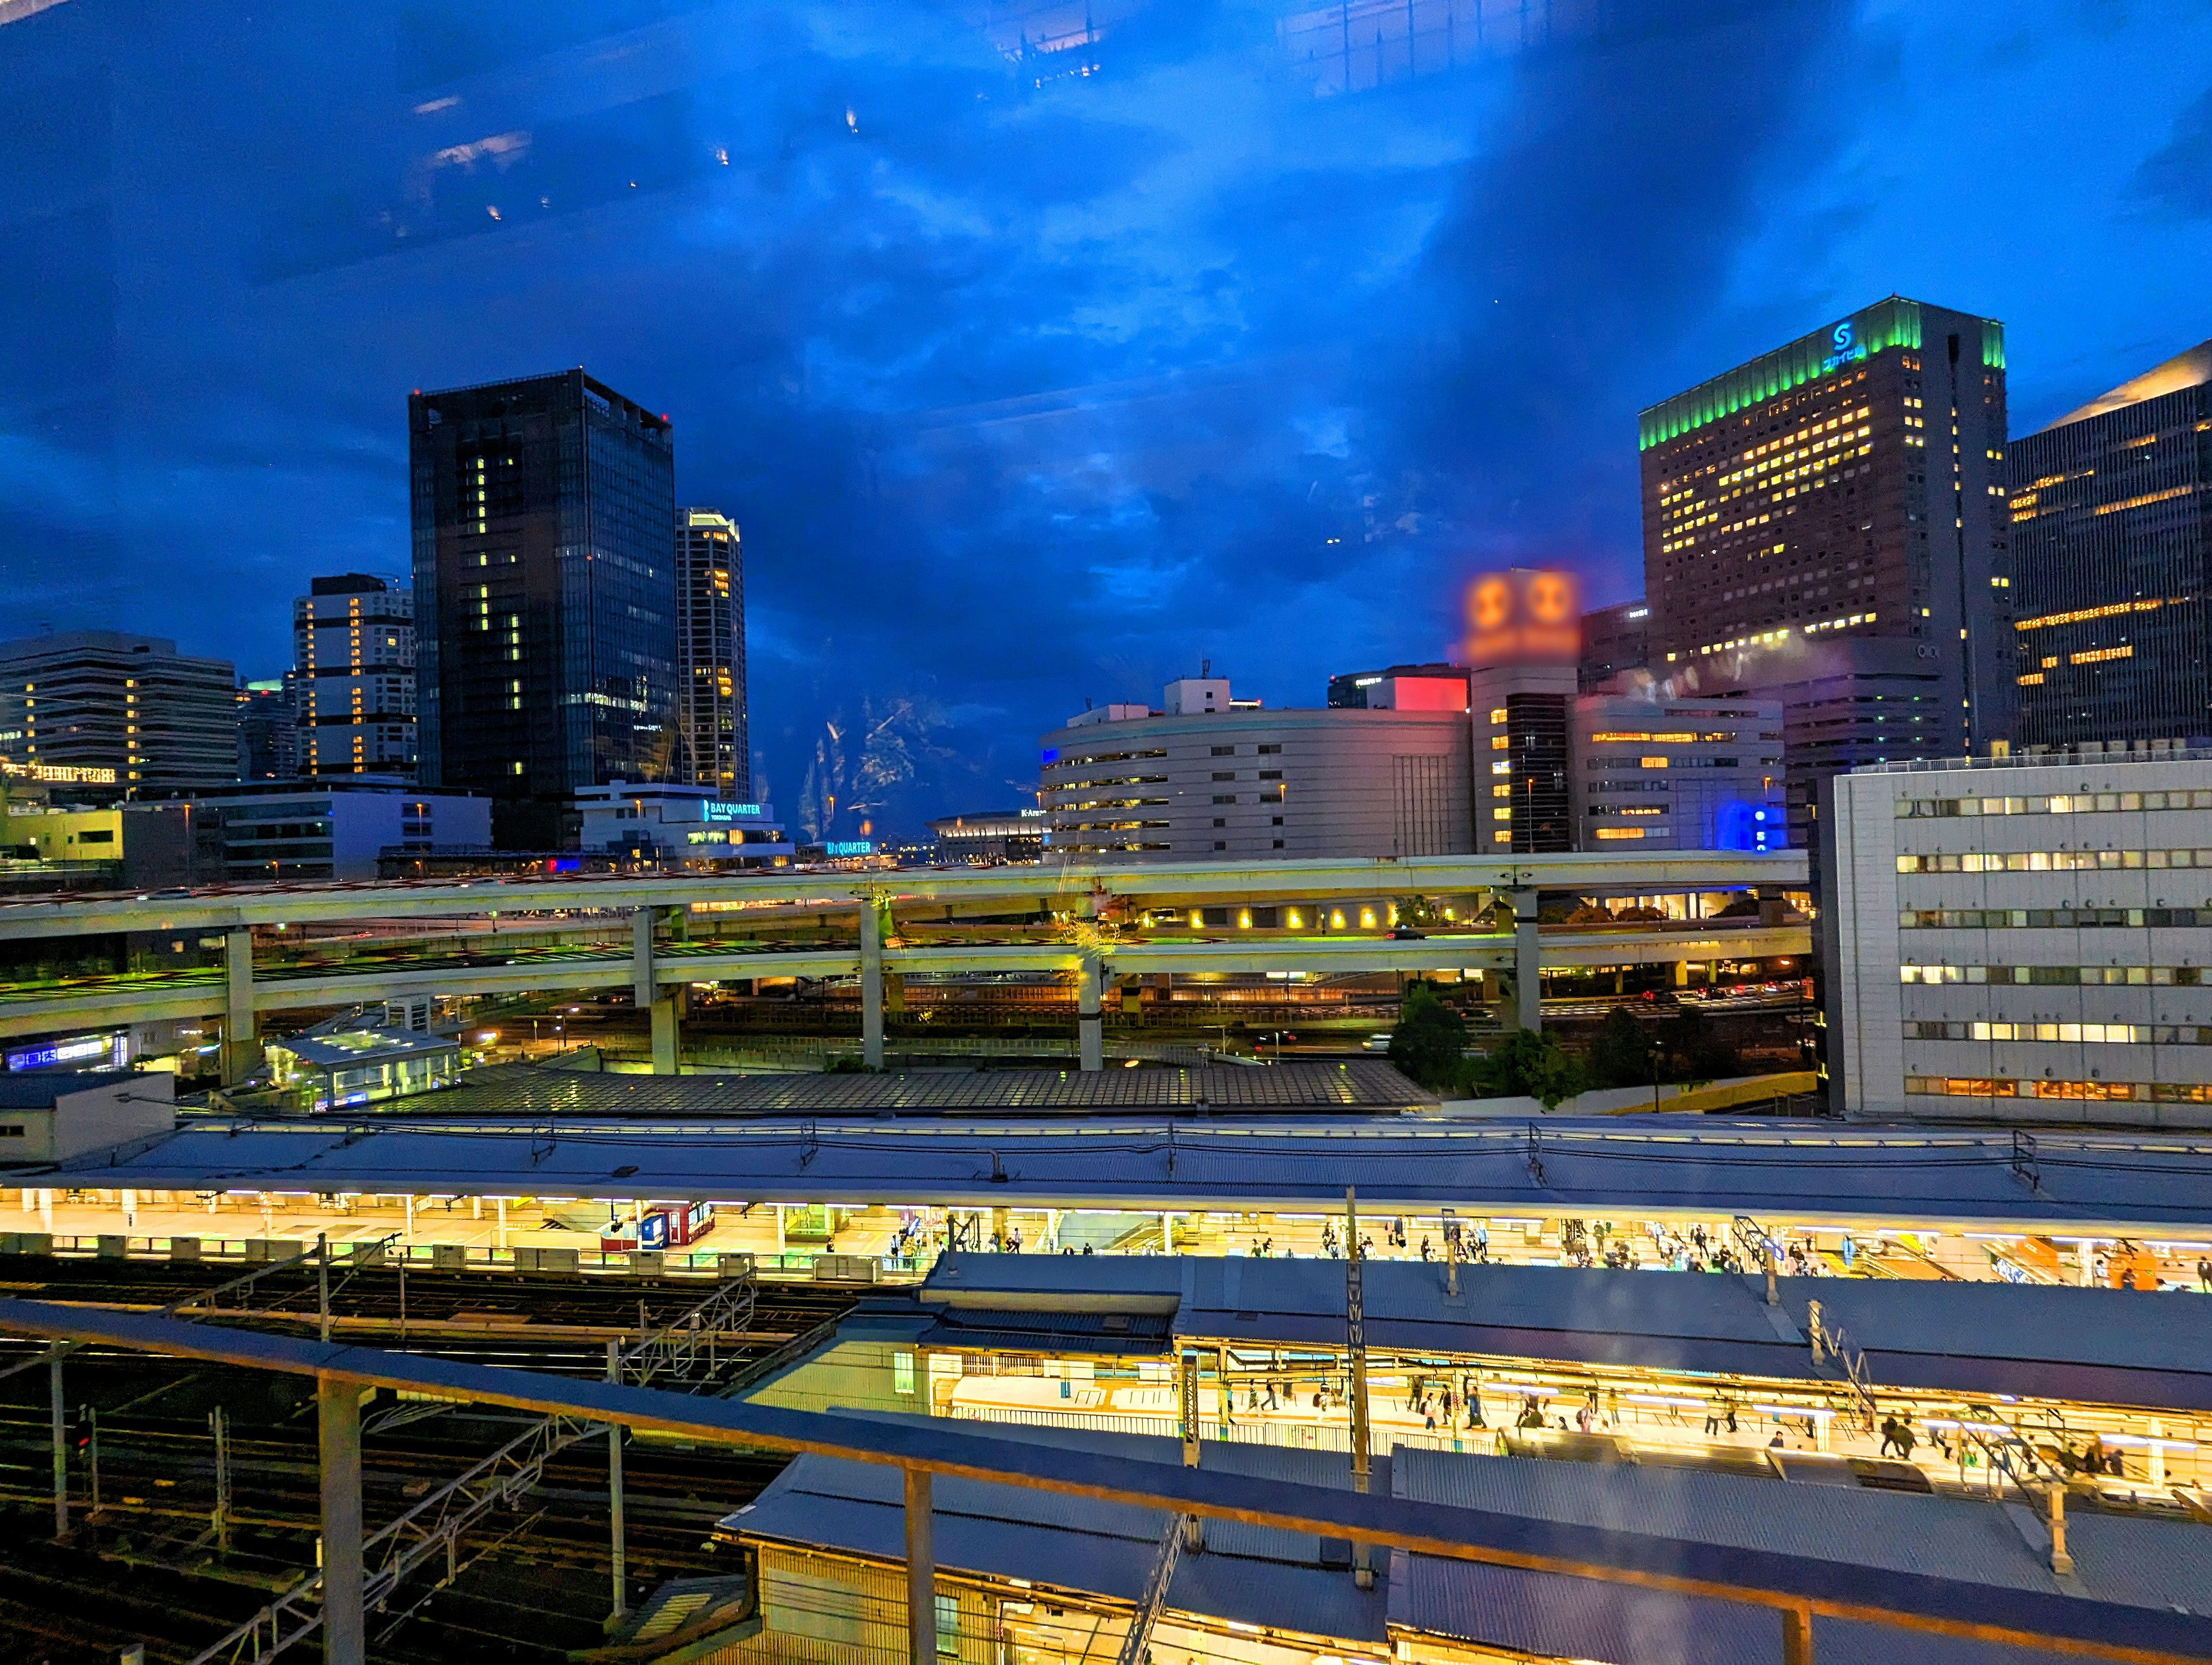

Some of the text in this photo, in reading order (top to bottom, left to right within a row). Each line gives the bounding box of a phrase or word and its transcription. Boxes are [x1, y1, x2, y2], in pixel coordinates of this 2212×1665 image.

[711, 803, 760, 815] BAY QUARTER
[839, 842, 870, 856] QUARTER
